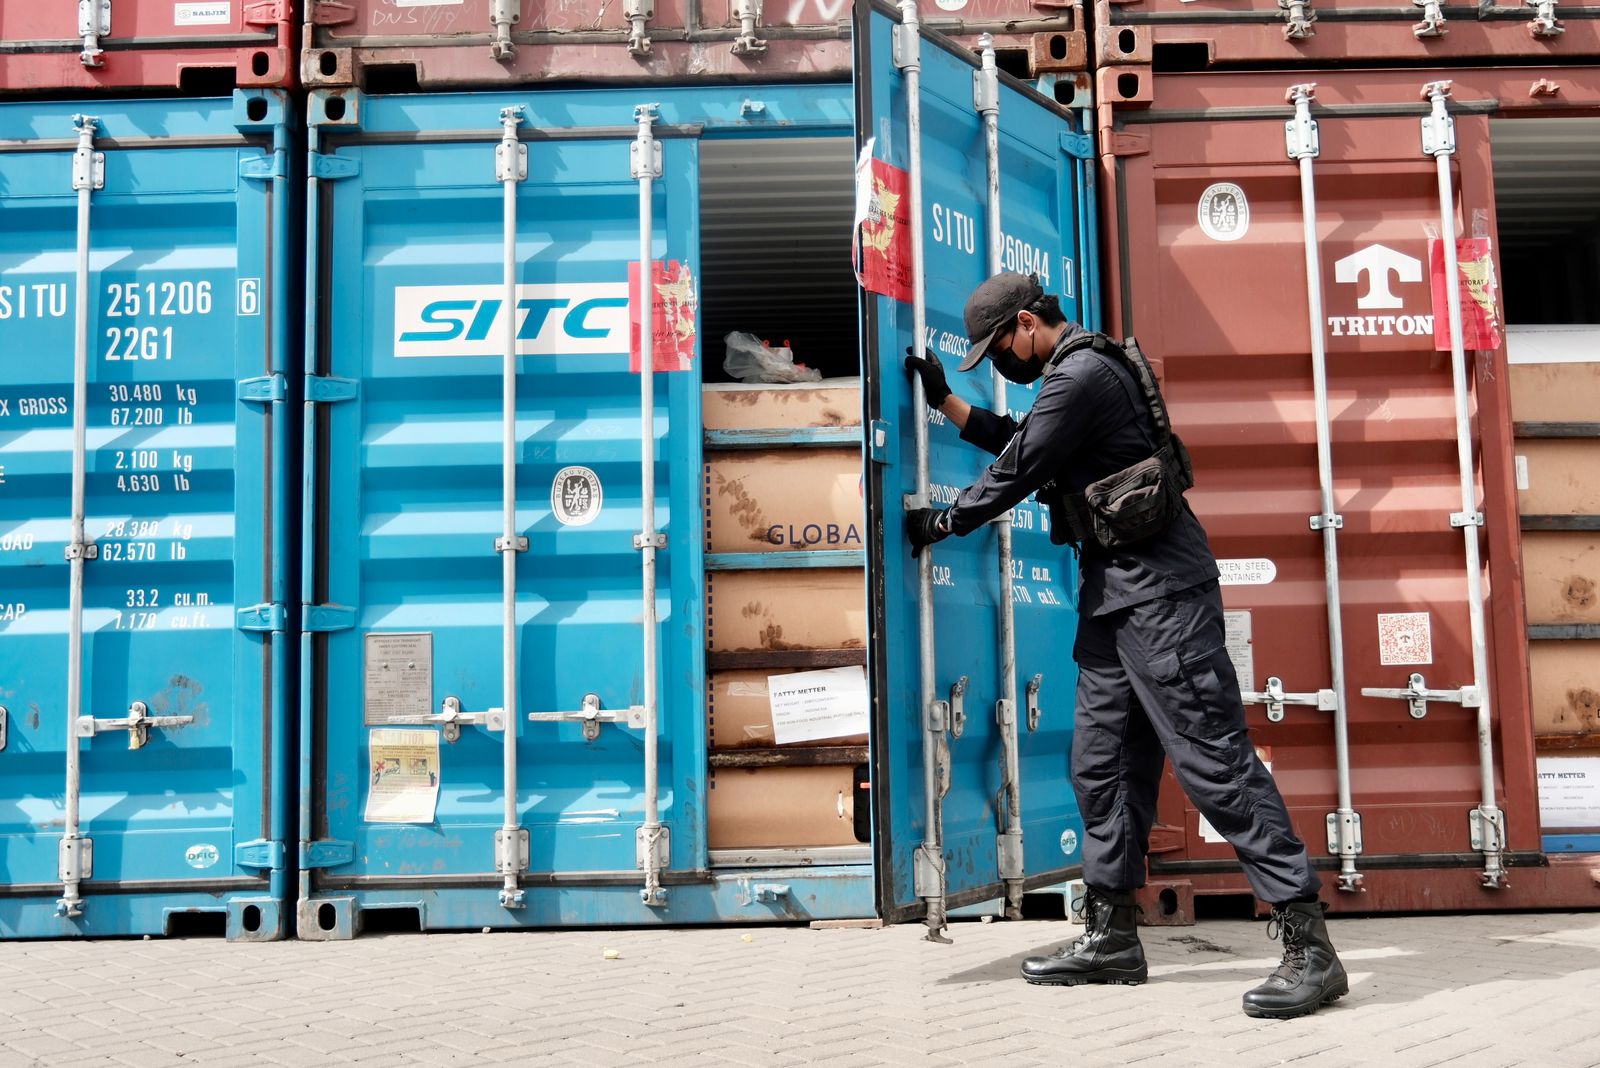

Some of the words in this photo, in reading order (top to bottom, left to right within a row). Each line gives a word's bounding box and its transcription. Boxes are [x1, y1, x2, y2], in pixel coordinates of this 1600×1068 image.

[932, 202, 975, 255] SITU
[1000, 231, 1050, 287] 260944
[1065, 261, 1072, 295] 1
[0, 283, 67, 319] SITU
[106, 281, 212, 317] 251206
[241, 280, 257, 314] 6
[398, 297, 629, 342] SITC
[1328, 315, 1435, 336] TRITON
[105, 326, 173, 361] 22G1
[940, 332, 969, 358] GROSS
[109, 384, 162, 402] 30.480
[176, 384, 197, 405] kg
[19, 397, 68, 416] GROSS
[111, 407, 163, 426] 67.200
[178, 407, 193, 425] lb
[115, 450, 158, 469] 2.100
[173, 450, 193, 472] kg
[117, 475, 160, 492] 4.630
[174, 474, 190, 491] lb
[105, 520, 159, 538] 28.380
[172, 520, 193, 540] kg
[1041, 512, 1049, 532] lb
[0, 533, 33, 550] OAD
[767, 524, 862, 546] GLOBA
[103, 543, 156, 561] 62.570
[171, 542, 186, 560] lb
[1032, 567, 1052, 582] cu.m.
[1245, 561, 1271, 571] STEEL
[1220, 572, 1262, 582] ONTAINER
[126, 589, 159, 607] 33.2
[174, 592, 214, 607] cu.m.
[115, 612, 157, 630] 1.170
[170, 611, 210, 629] cu.ft.
[773, 690, 796, 698] FATTY
[797, 686, 827, 695] METTER
